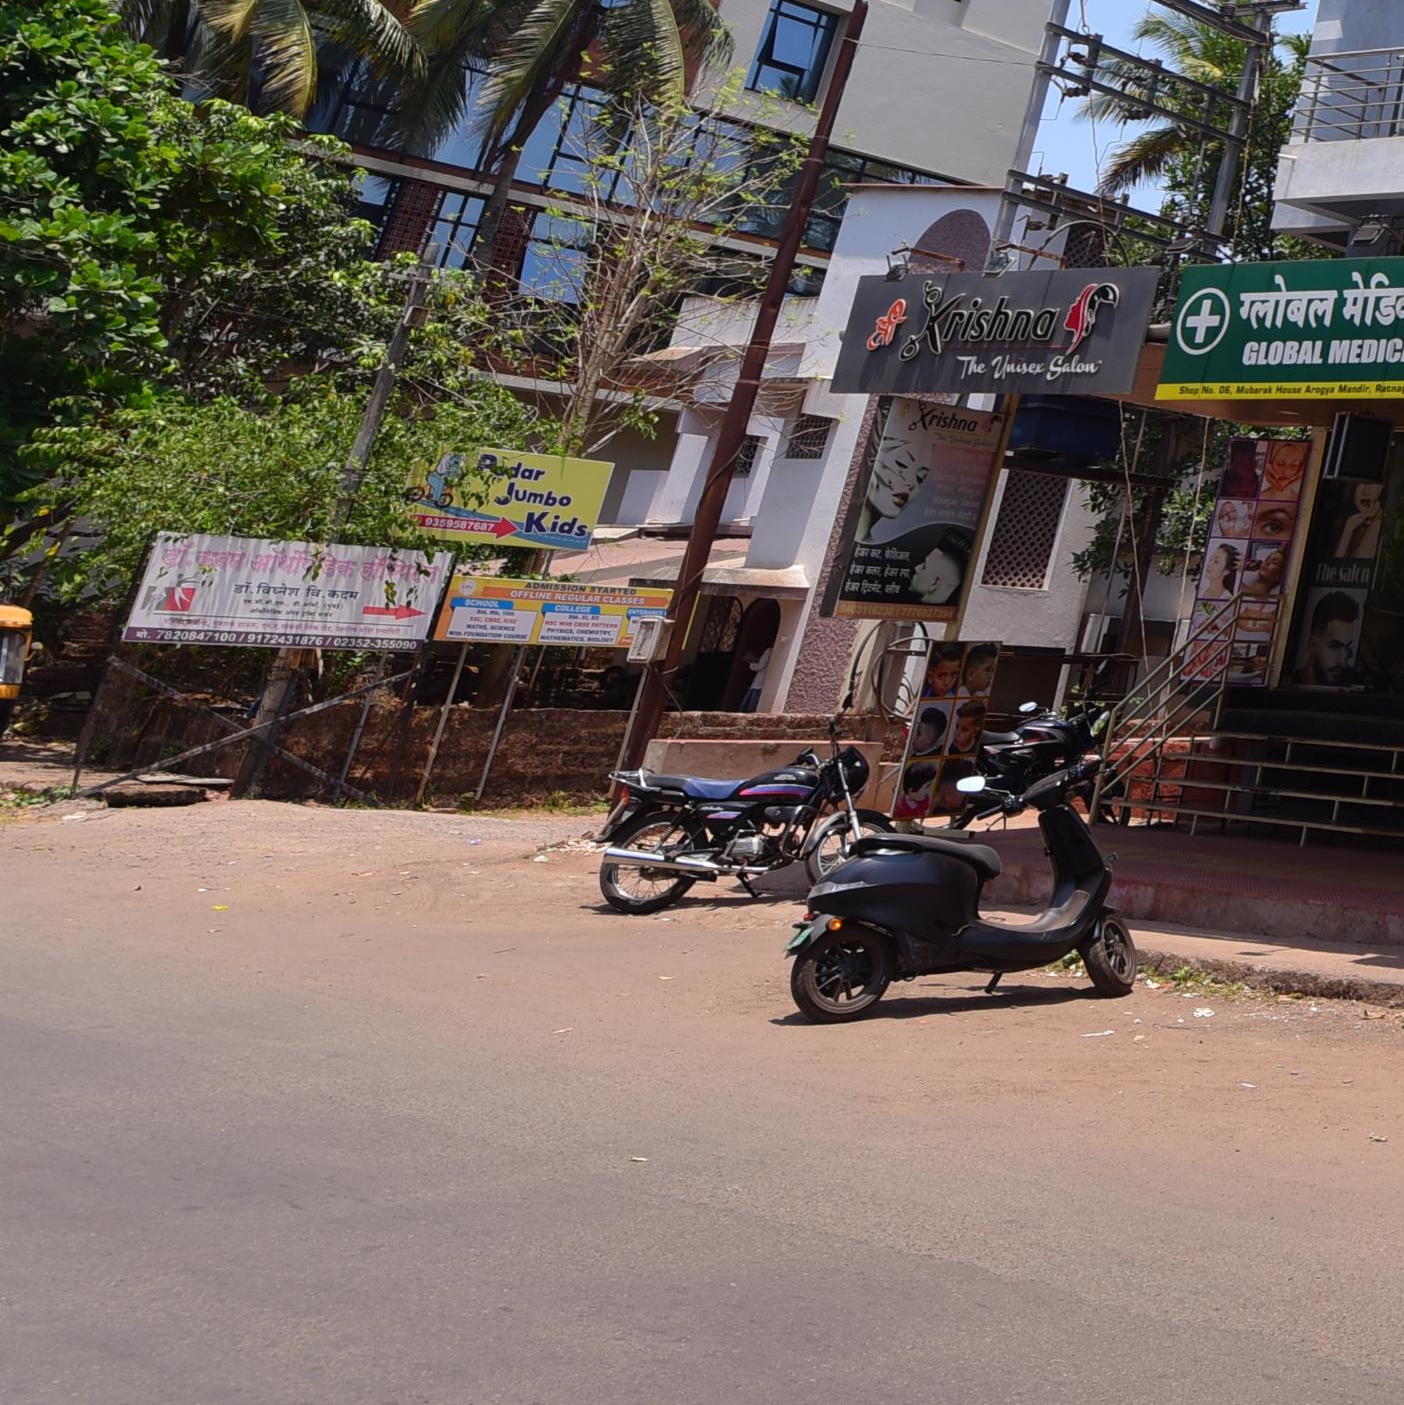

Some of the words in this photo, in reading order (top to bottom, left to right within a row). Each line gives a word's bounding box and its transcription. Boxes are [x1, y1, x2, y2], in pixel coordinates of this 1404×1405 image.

[1239, 274, 1338, 330] ग्लोबल
[900, 280, 1061, 361] Krishna
[1242, 340, 1323, 365] GLOBAL
[957, 356, 987, 380] The
[992, 355, 1044, 380] Unisex
[1047, 355, 1100, 380] Salon
[1179, 385, 1199, 396] Shop
[1201, 385, 1214, 395] No.
[1235, 384, 1272, 394] Mubarak
[1275, 384, 1301, 394] House
[1304, 384, 1335, 396] Arogya
[494, 482, 572, 507] Jumbo
[425, 517, 495, 531] 9359587687
[524, 512, 588, 537] Kids
[510, 590, 553, 600] OFFLINE
[555, 595, 600, 603] REGULAR
[602, 596, 645, 605] CLASSES
[523, 582, 585, 592] ADMISSION
[590, 586, 637, 595] STARTED
[464, 599, 500, 607] SCHOOL
[554, 605, 592, 613] COLLEGE
[157, 630, 236, 643] 7820847100
[247, 633, 323, 645] 9172431876
[334, 637, 417, 649] 02352-355090
